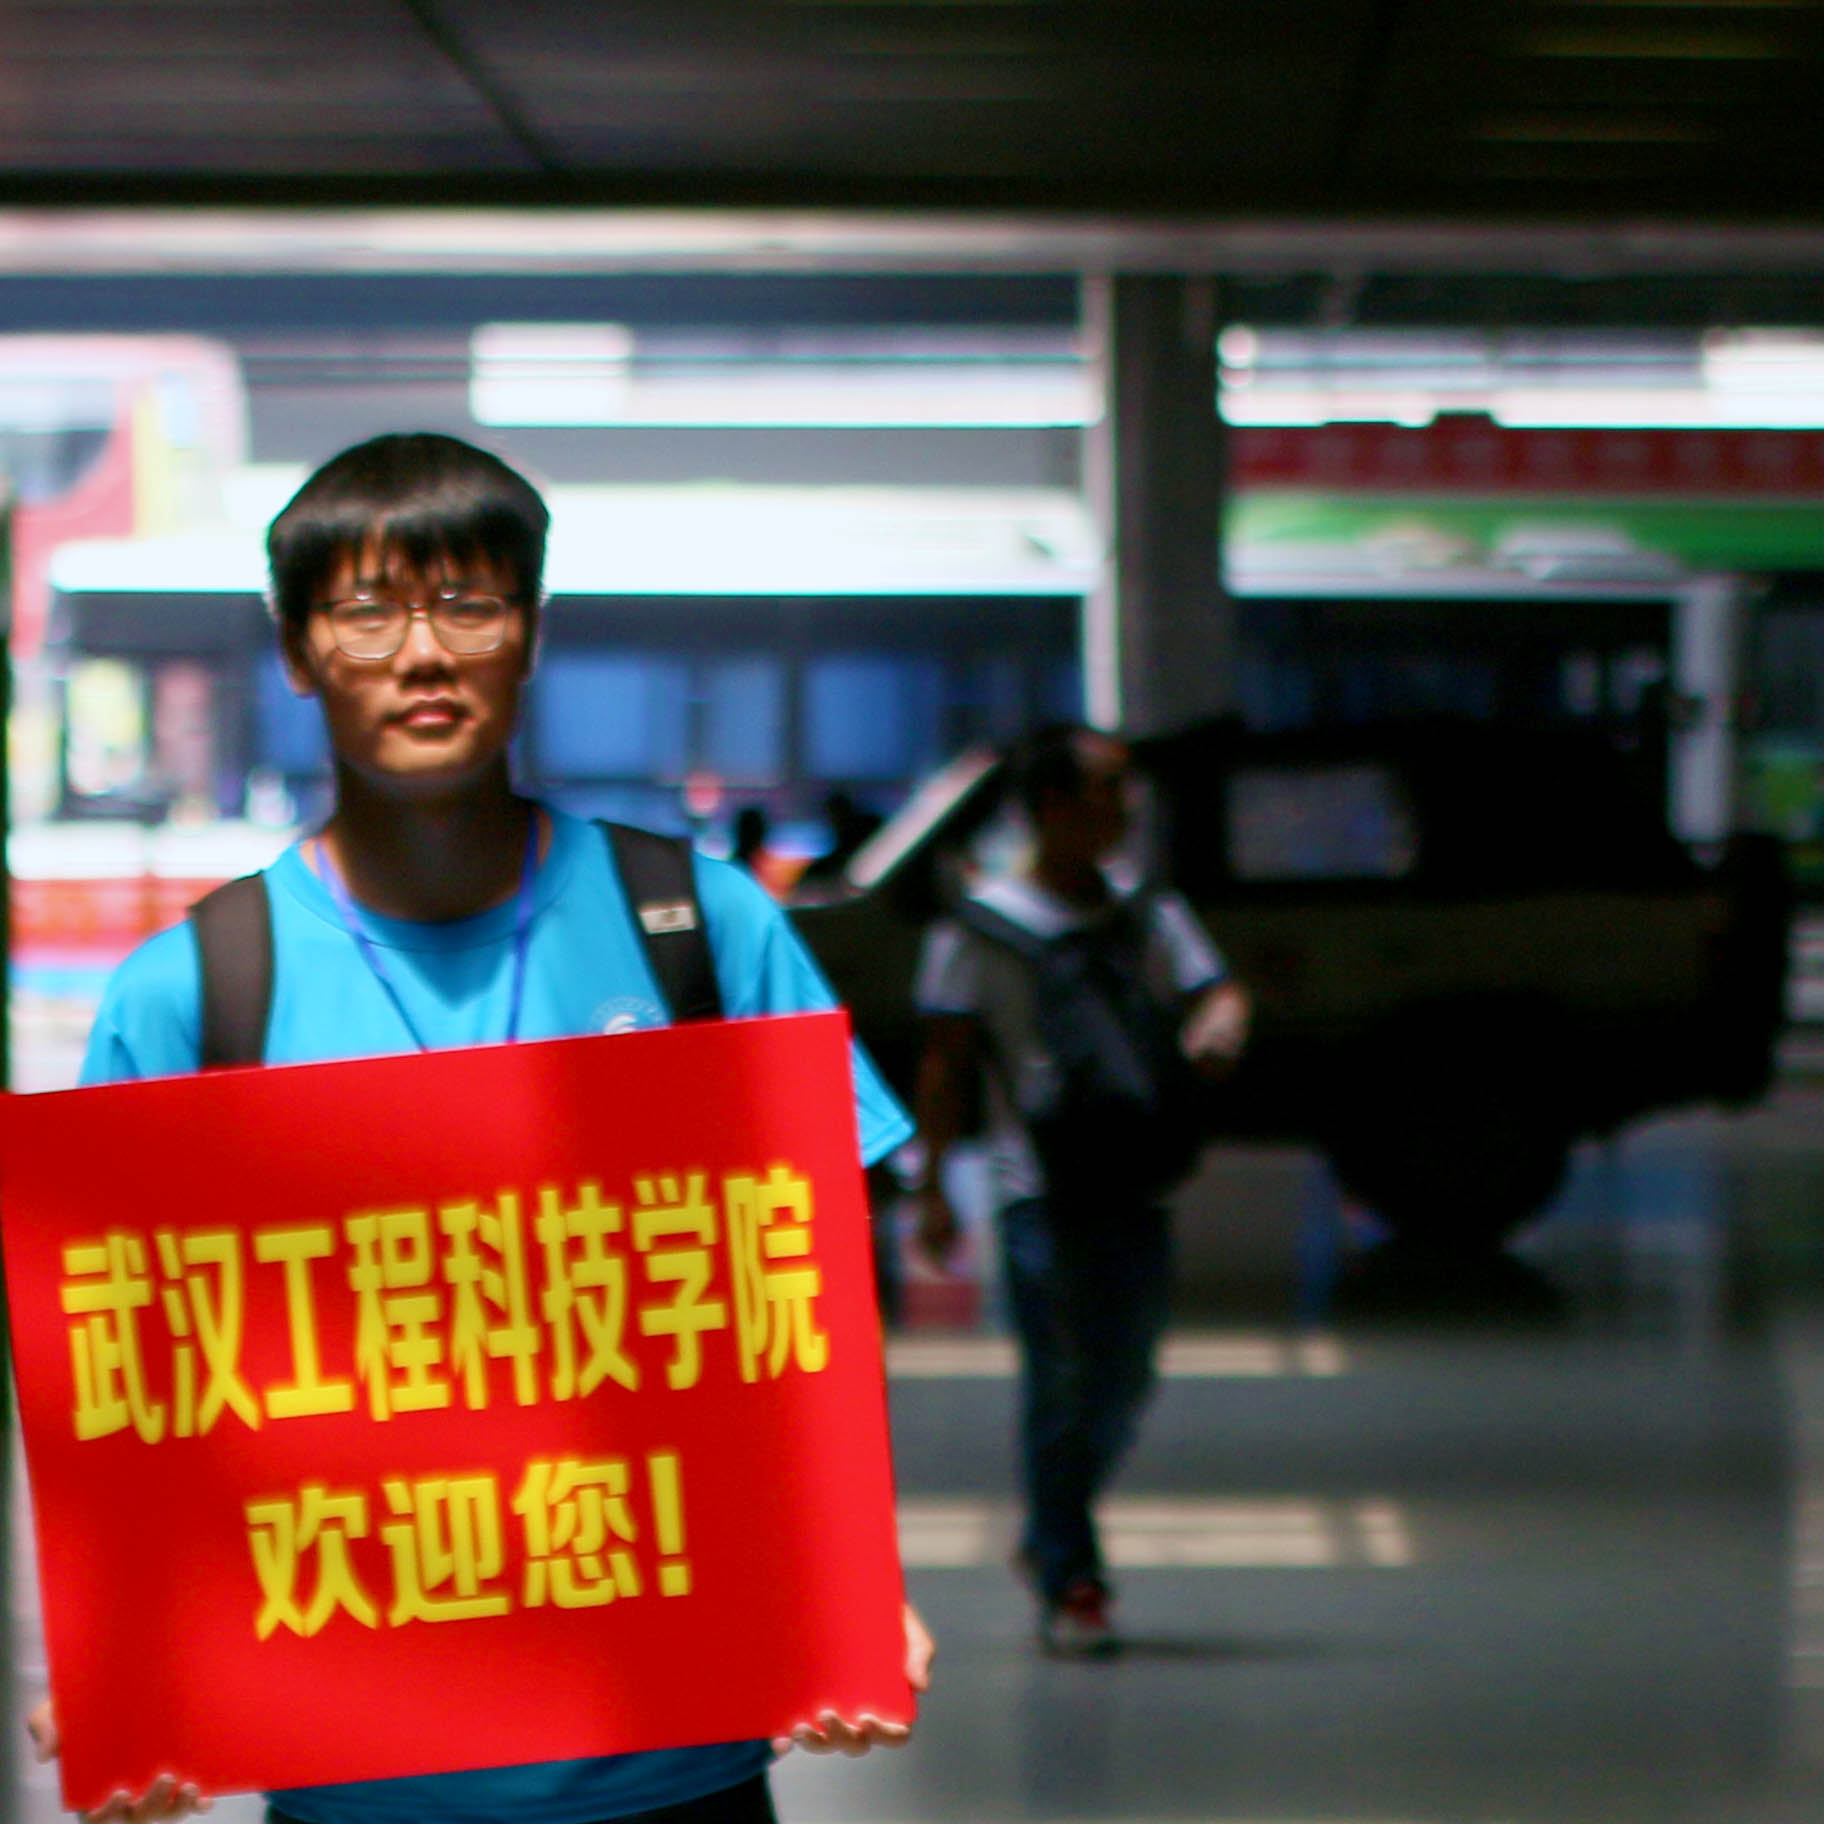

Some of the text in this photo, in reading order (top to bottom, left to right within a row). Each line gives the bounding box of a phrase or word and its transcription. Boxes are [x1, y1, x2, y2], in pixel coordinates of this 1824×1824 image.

[60, 1164, 829, 1443] 武汉工程科技学院
[244, 1446, 693, 1642] 欢迎您!
